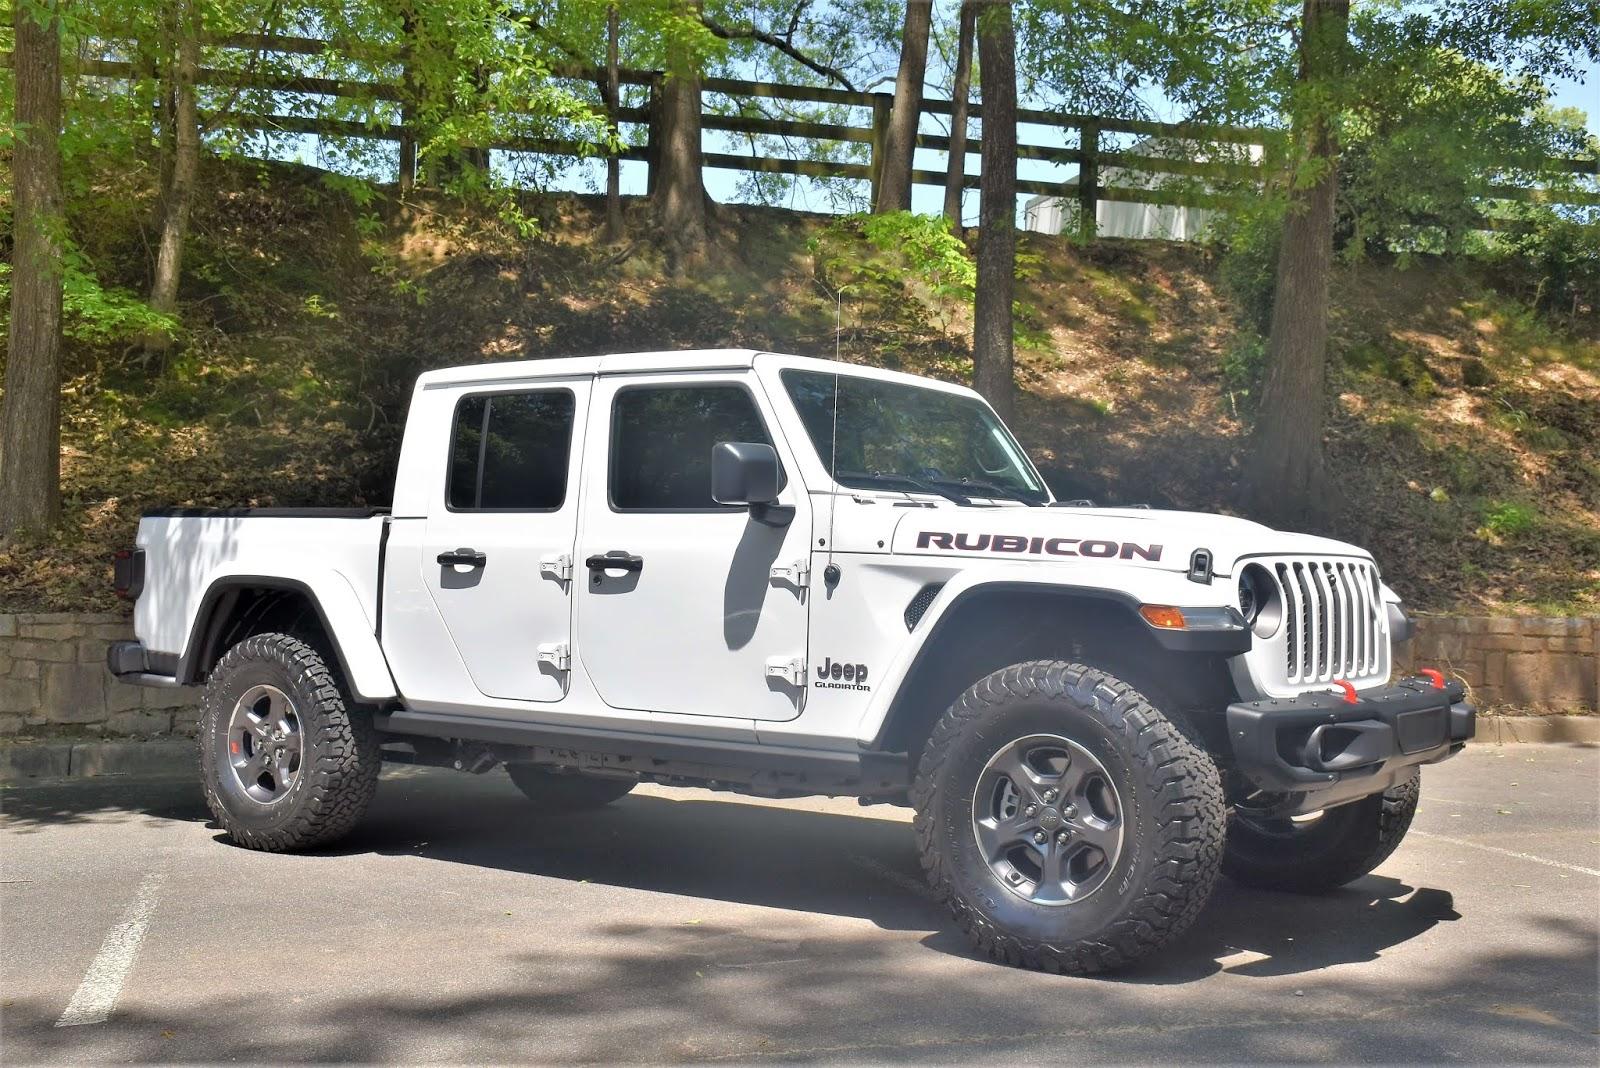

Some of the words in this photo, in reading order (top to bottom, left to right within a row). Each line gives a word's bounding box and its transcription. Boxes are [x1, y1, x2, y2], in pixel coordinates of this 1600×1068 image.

[916, 531, 1163, 561] RUBICON
[817, 656, 868, 685] Jeep
[815, 681, 871, 692] GLADIATOR
